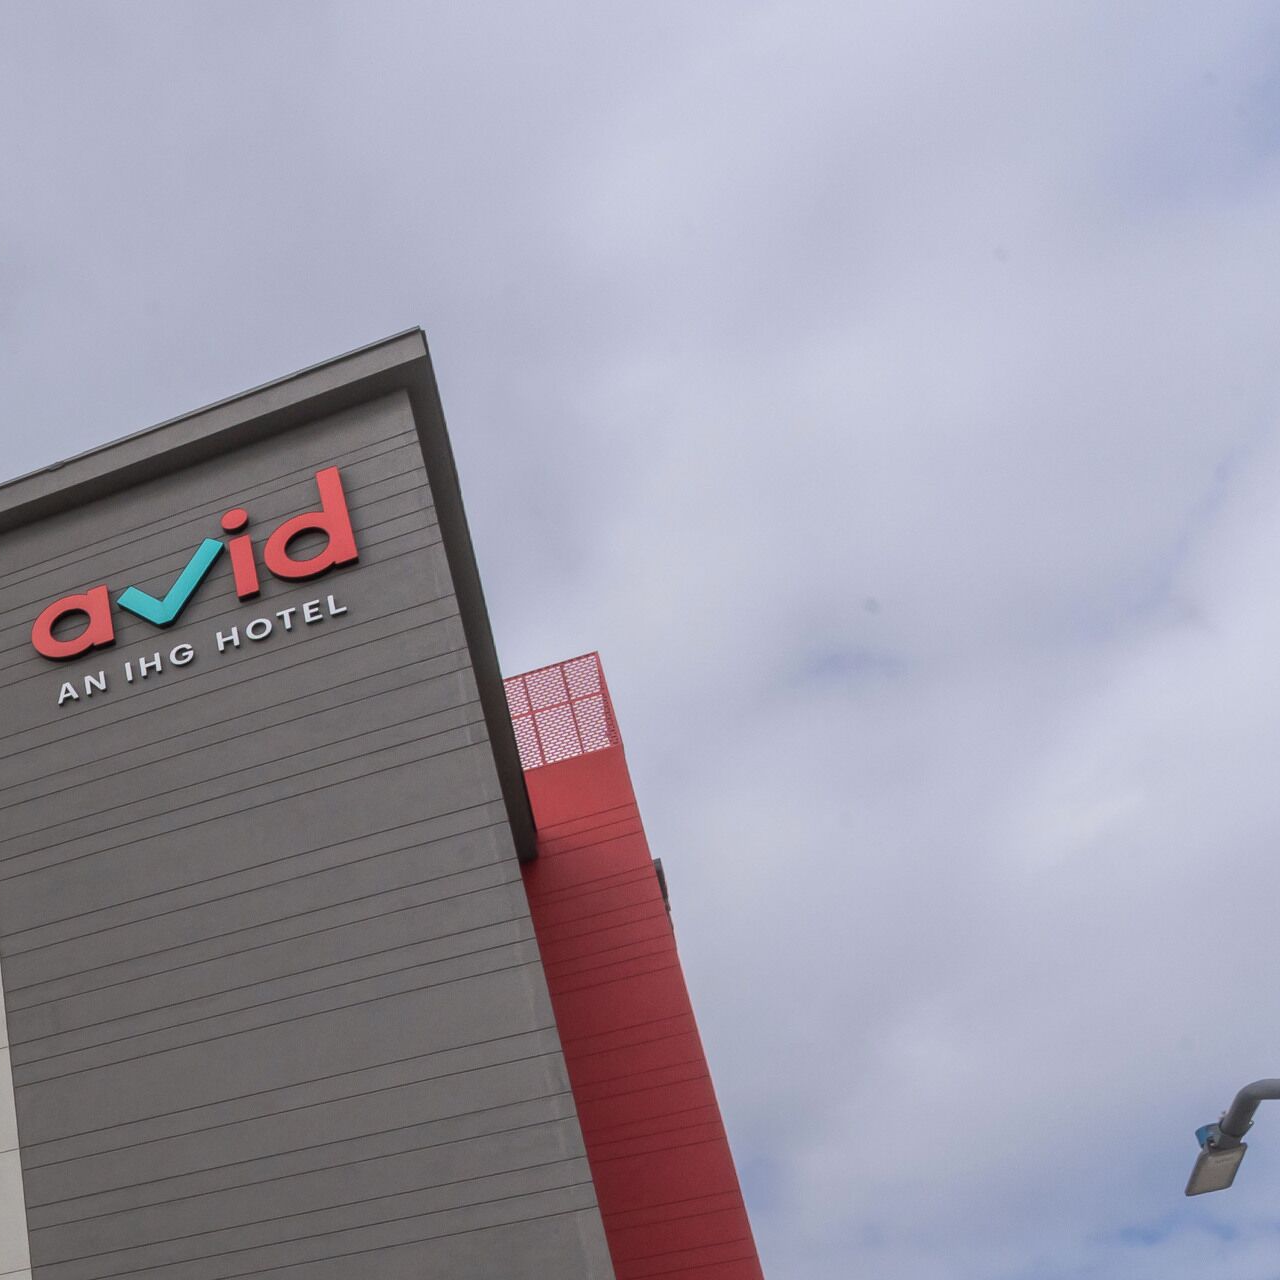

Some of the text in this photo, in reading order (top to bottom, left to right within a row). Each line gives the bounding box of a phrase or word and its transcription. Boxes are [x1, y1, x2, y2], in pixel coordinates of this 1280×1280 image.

[32, 465, 359, 660] avid
[58, 595, 347, 706] AN IHG HOTEL
